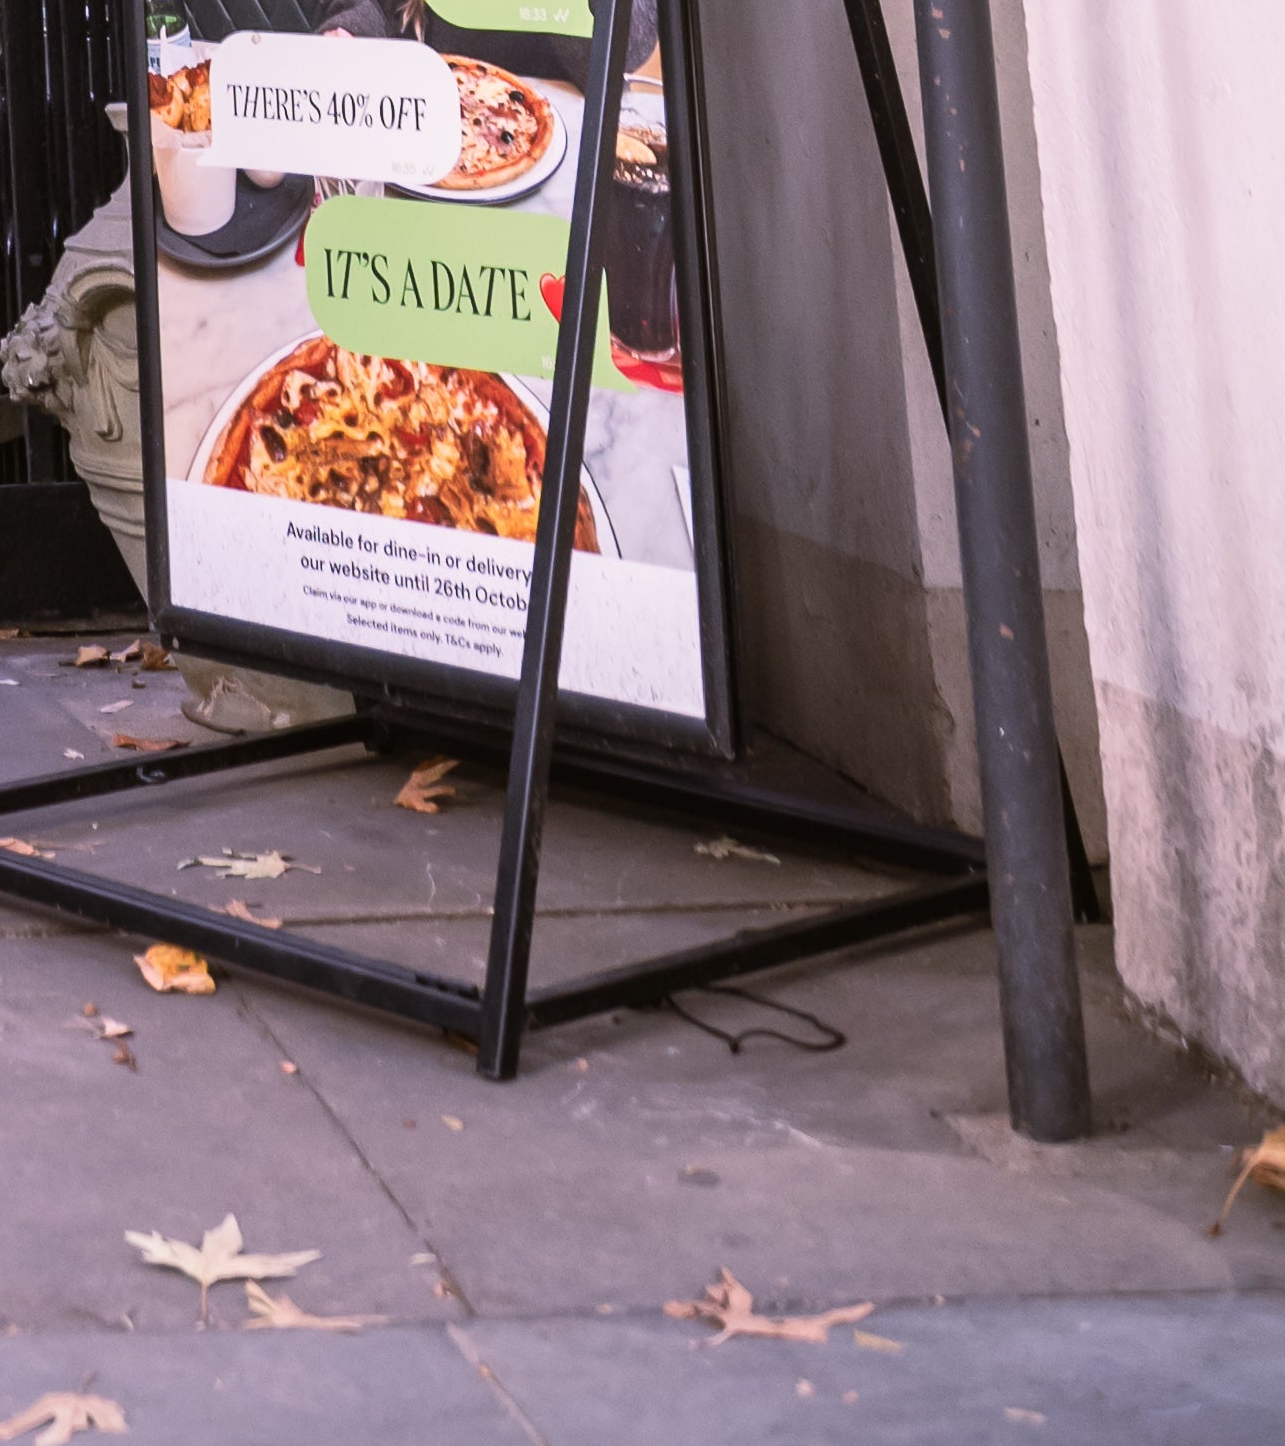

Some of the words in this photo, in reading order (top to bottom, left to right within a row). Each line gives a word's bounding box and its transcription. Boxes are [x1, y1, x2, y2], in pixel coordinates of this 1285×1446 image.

[227, 84, 321, 124] THERE'S
[327, 92, 373, 128] 40%
[380, 95, 426, 131] OFF
[324, 248, 391, 305] IT'S
[400, 258, 425, 309] A
[430, 260, 531, 322] DATE
[286, 521, 353, 549] Available
[357, 534, 379, 553] for
[383, 540, 441, 565] dine-in
[445, 556, 462, 569] or
[466, 556, 532, 587] delivery
[300, 556, 325, 572] our
[330, 560, 390, 585] website
[394, 574, 430, 593] until
[434, 578, 470, 601] 26th
[475, 586, 528, 612] Octob
[303, 585, 328, 599] Claim
[330, 591, 342, 602] via
[344, 594, 357, 604] our
[360, 598, 377, 611] app
[390, 603, 434, 621] download
[443, 613, 466, 627] code
[468, 618, 490, 632] from
[492, 624, 508, 635] our
[346, 613, 388, 633] Selected
[391, 623, 417, 638] items
[420, 629, 443, 645] only.
[445, 634, 471, 649] T&Cs
[473, 640, 503, 658] apply.
